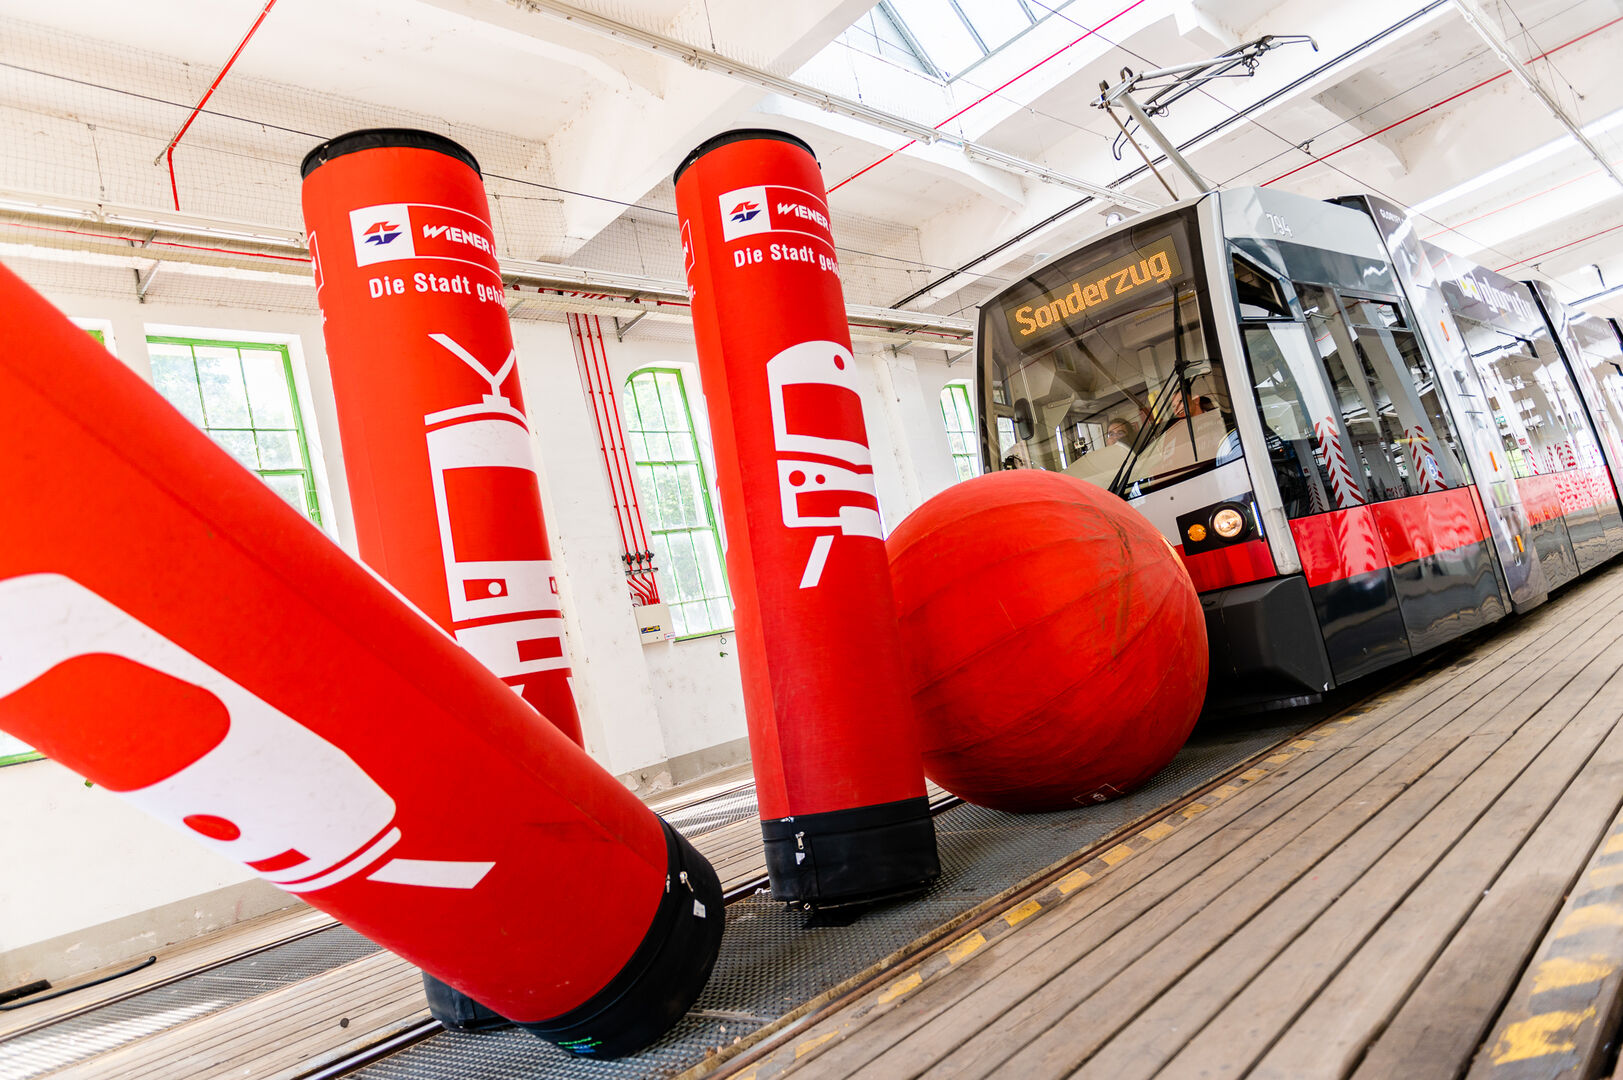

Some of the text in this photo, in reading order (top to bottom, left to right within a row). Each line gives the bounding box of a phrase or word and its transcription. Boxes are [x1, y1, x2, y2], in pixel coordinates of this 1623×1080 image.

[777, 202, 830, 231] WIENER
[1266, 213, 1293, 237] 794
[423, 223, 491, 254] WIENER
[734, 247, 763, 268] Die
[770, 243, 816, 264] Stadt
[369, 275, 405, 299] Die
[413, 272, 471, 295] Stadt
[1015, 251, 1172, 336] Sonderzug
